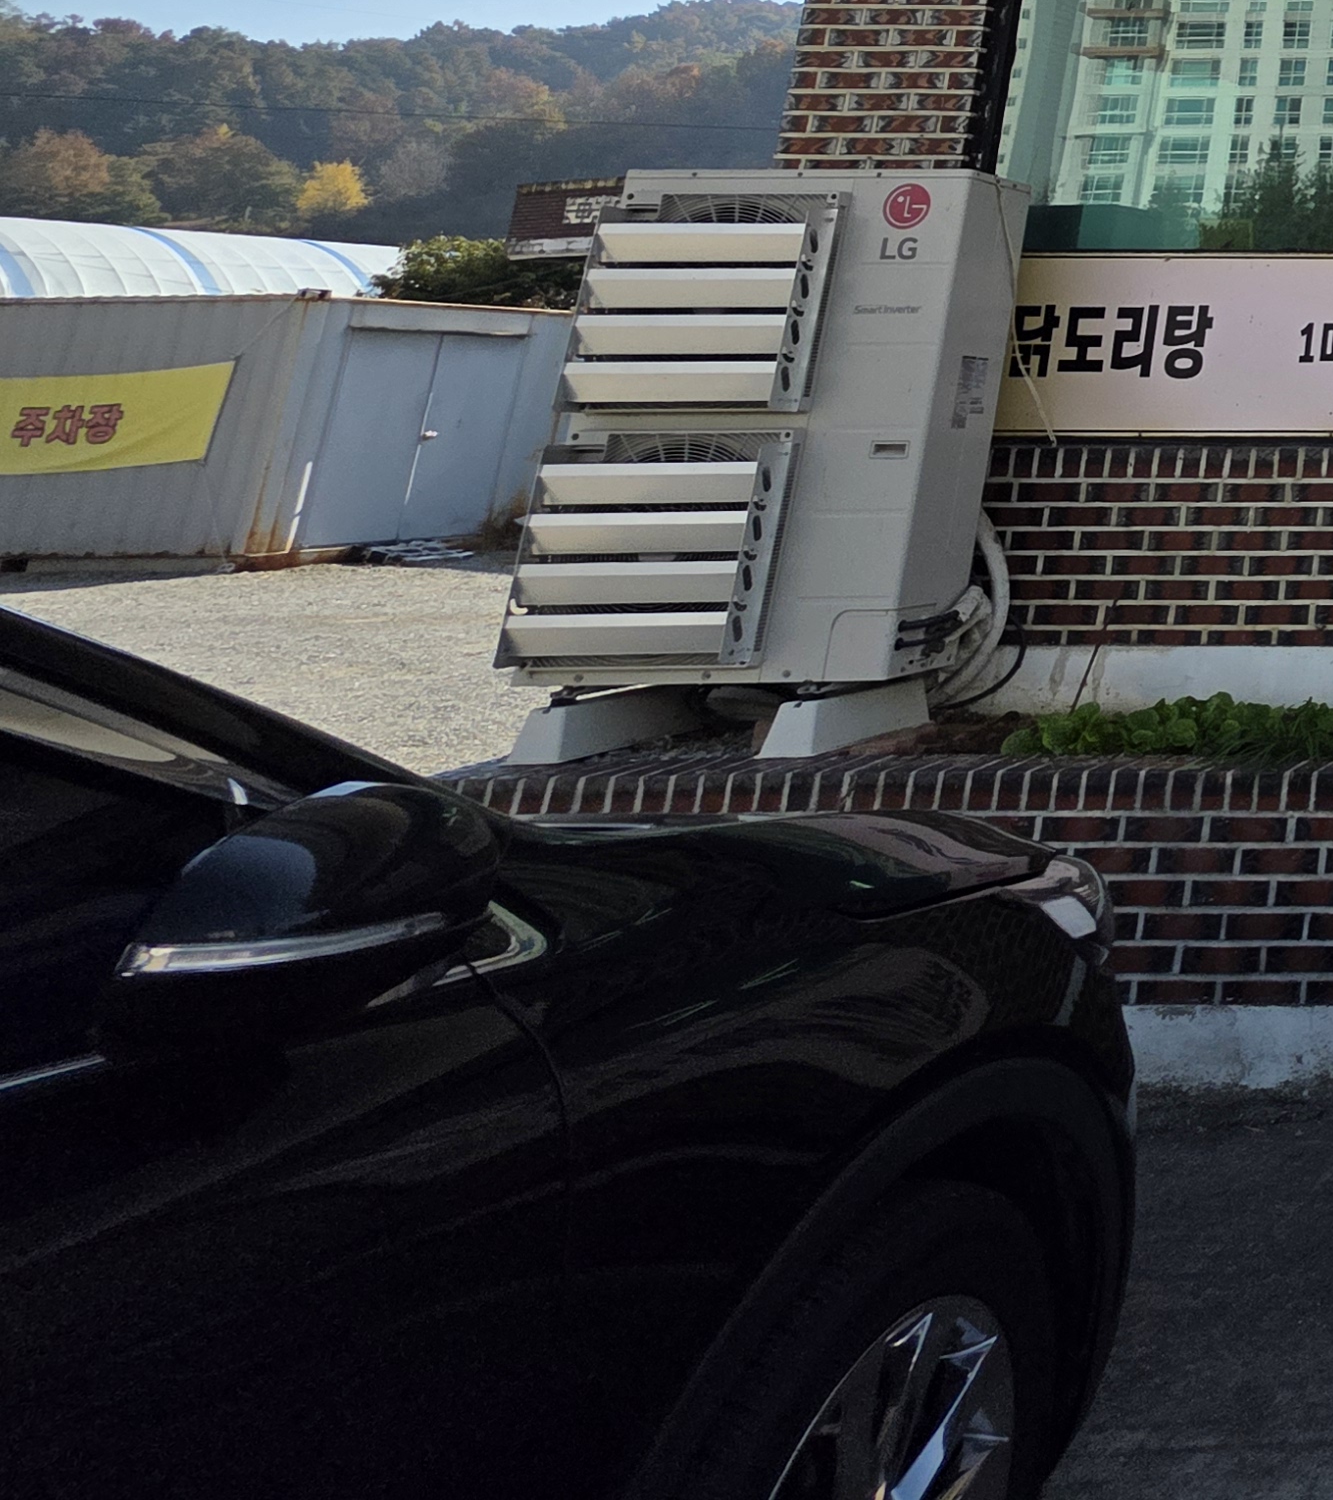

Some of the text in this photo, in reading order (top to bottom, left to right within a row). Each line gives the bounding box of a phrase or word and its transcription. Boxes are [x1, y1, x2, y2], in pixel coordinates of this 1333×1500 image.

[879, 237, 918, 260] LG
[1009, 304, 1214, 379] 닭도리탕
[10, 403, 125, 448] 주차장
